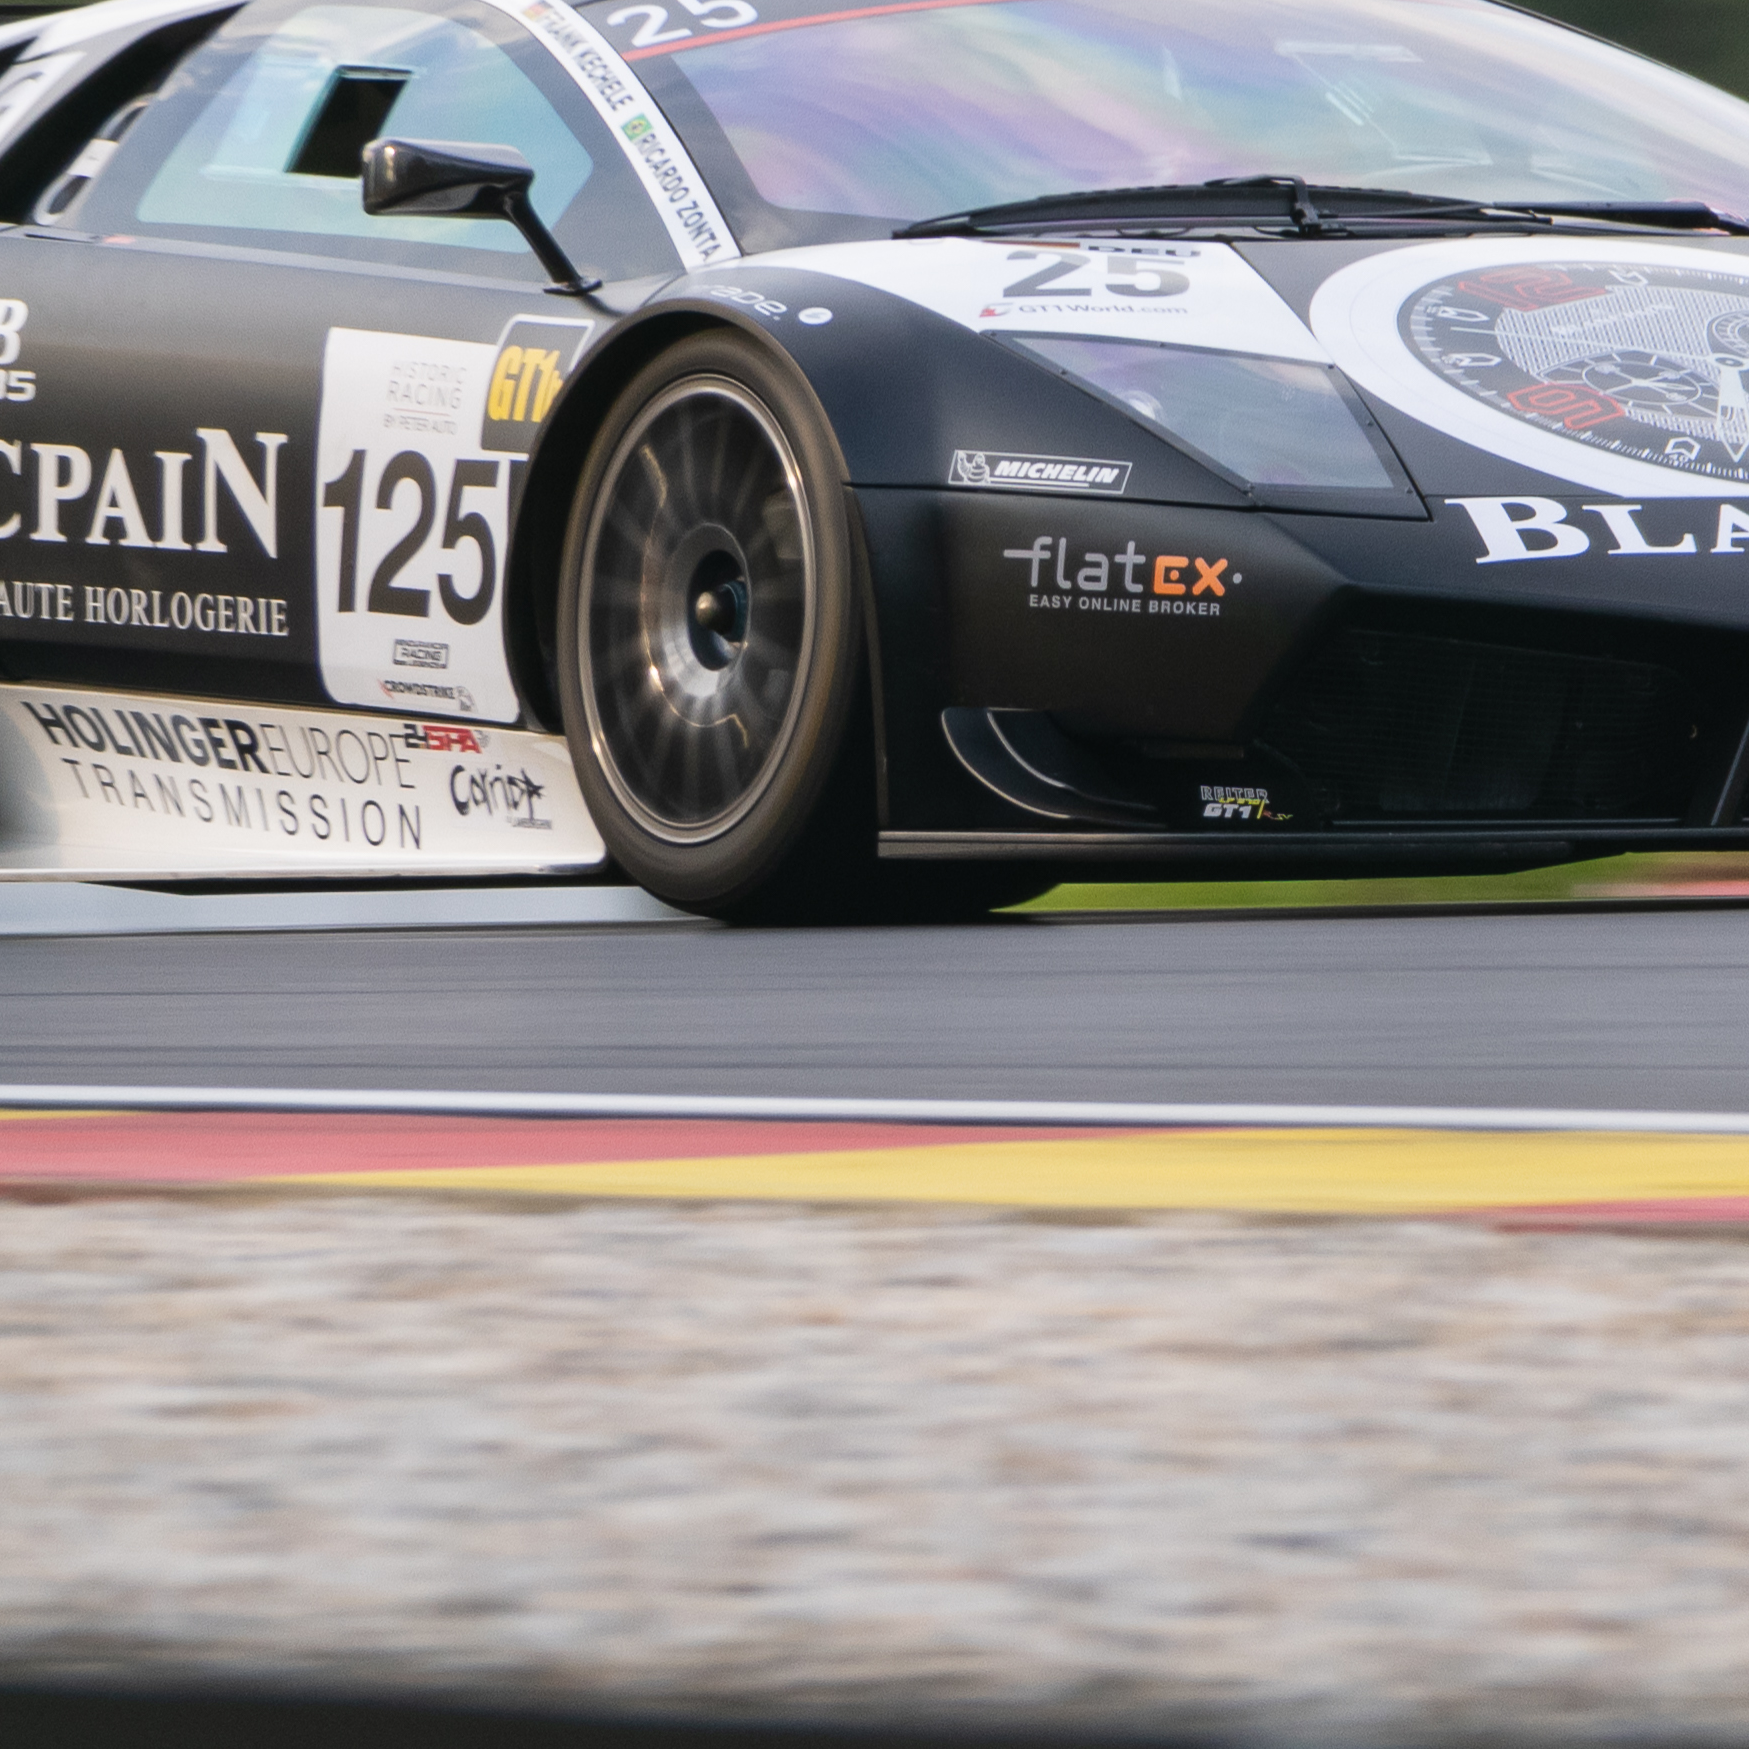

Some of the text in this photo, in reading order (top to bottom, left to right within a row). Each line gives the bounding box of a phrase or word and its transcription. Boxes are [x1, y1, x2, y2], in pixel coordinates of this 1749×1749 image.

[634, 131, 725, 263] RICARDO ZONTA
[1002, 250, 1191, 299] 25
[392, 360, 467, 385] HISTORIC
[385, 379, 463, 410] RACING
[994, 460, 1120, 484] MICHELIN
[322, 448, 498, 626] 125
[84, 585, 290, 638] HORLOGERIE
[1029, 593, 1221, 616] EASY ONLINE BROKER
[383, 679, 456, 700] CROWDSTRIKE
[60, 757, 423, 850] TRANSMISSION
[1199, 785, 1270, 804] REITER
[1203, 802, 1253, 819] GT1
